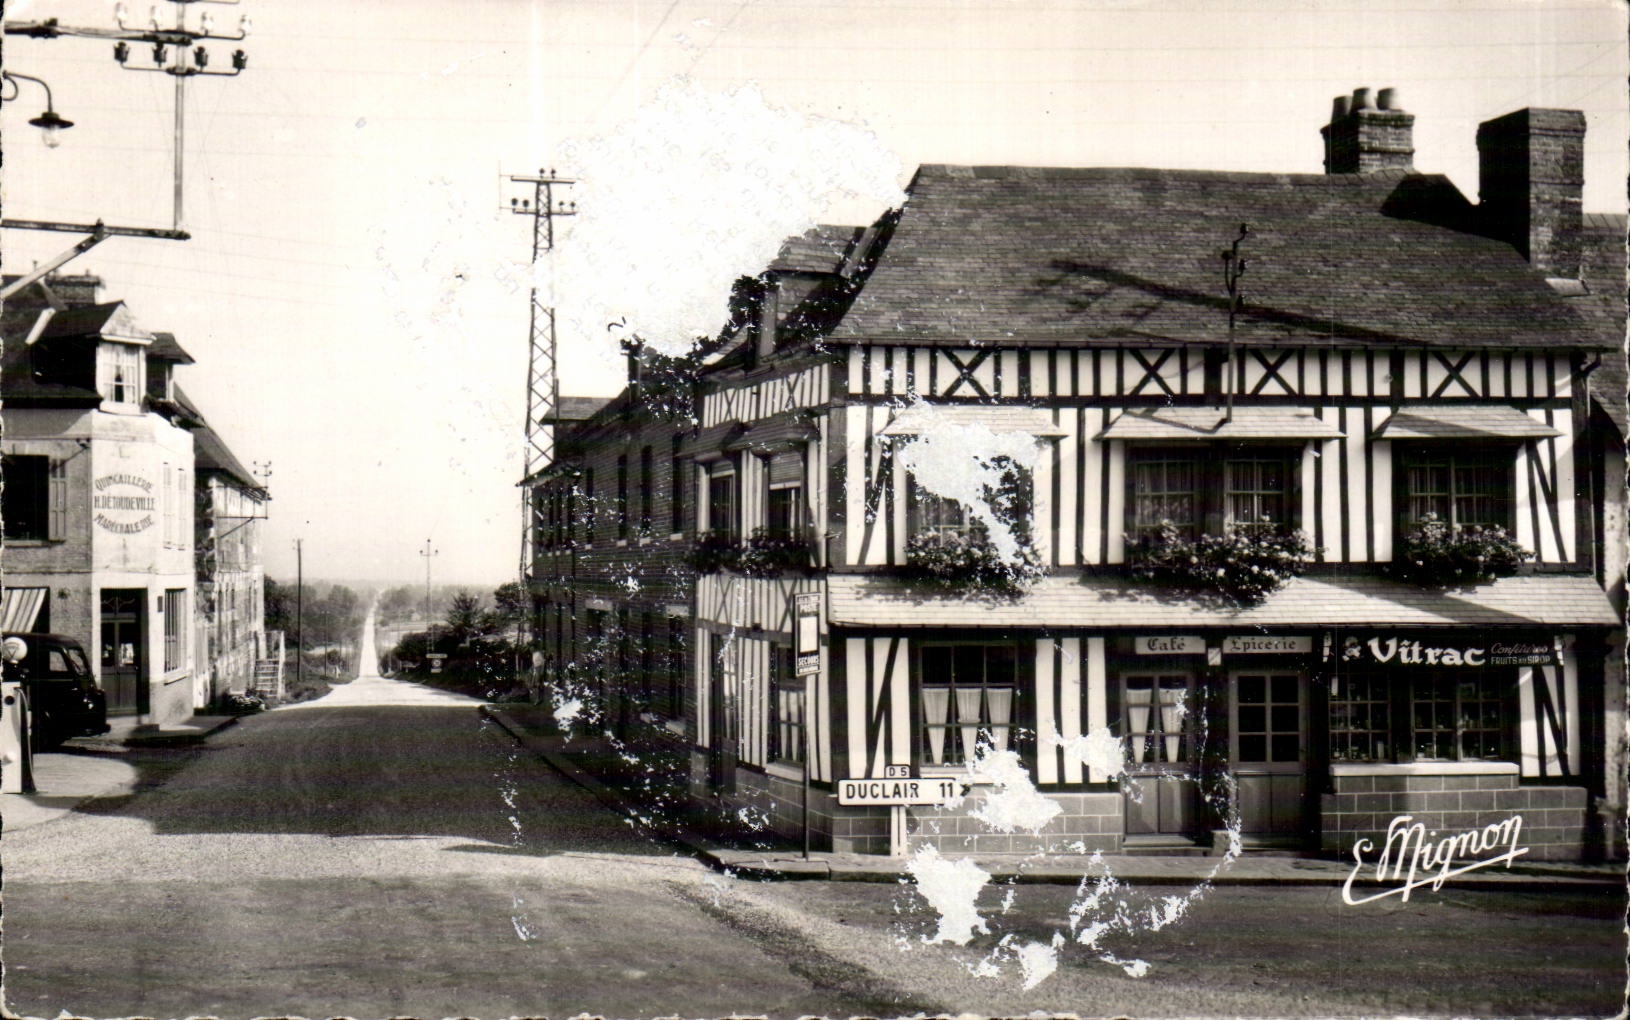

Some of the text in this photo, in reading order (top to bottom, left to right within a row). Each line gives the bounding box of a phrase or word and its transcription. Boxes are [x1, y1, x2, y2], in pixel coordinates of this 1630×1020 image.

[1147, 636, 1187, 652] Café
[1490, 656, 1518, 665] FRUITS
[1527, 655, 1551, 665] SIROP
[889, 767, 908, 777] D 5
[846, 782, 954, 799] DUCLAIR 11
